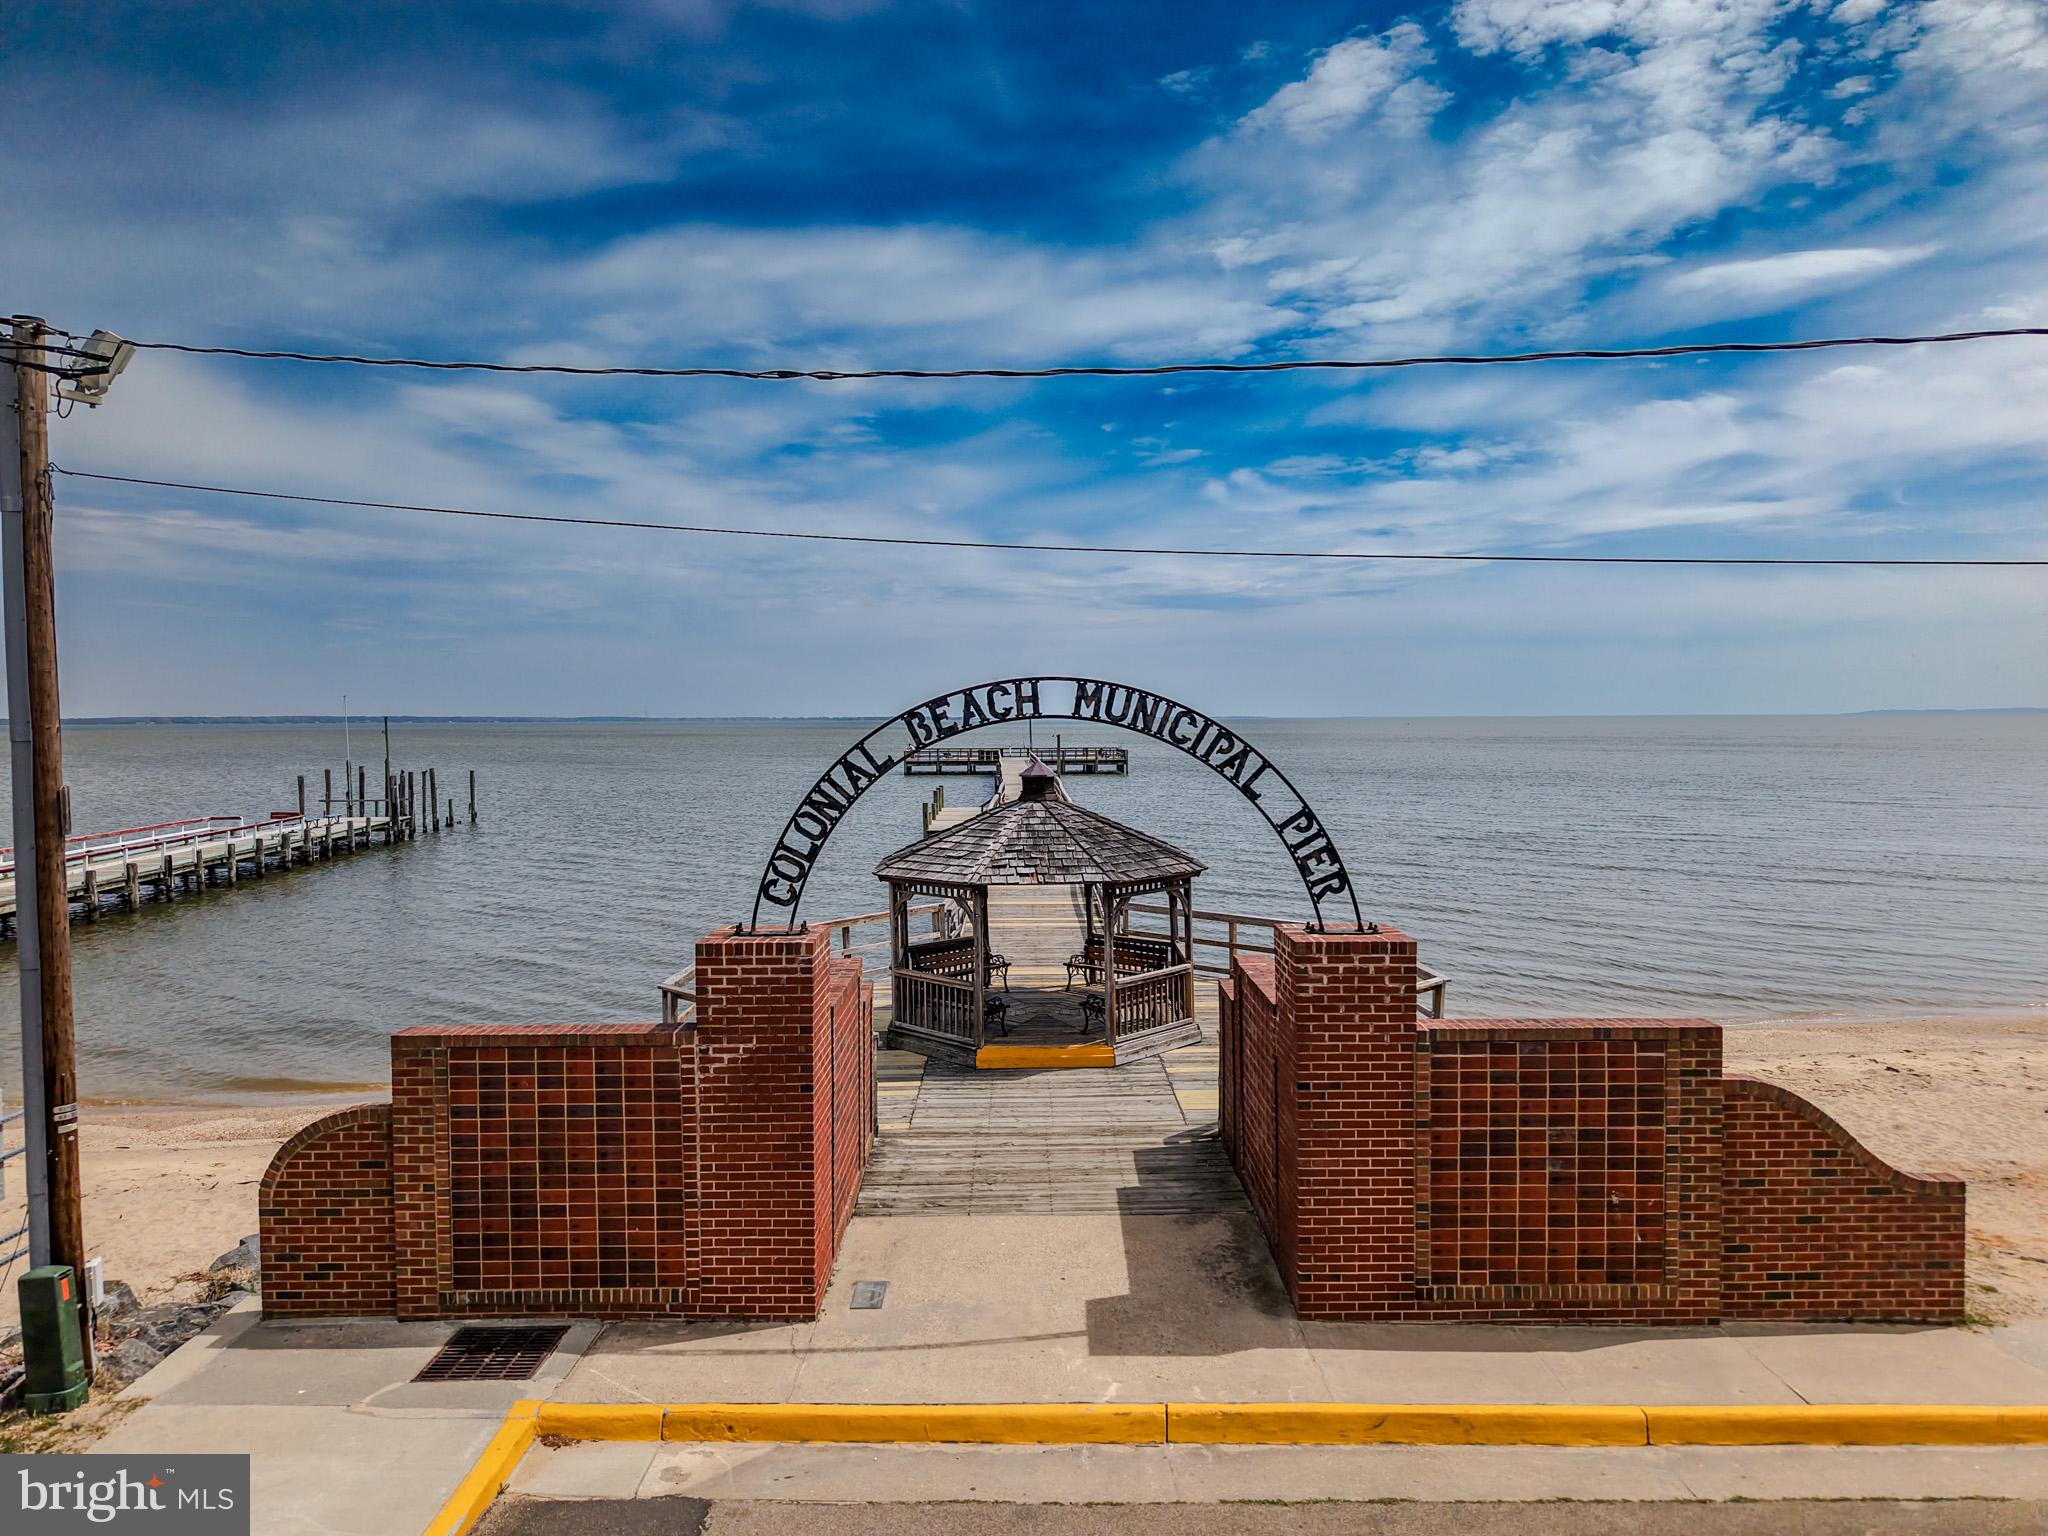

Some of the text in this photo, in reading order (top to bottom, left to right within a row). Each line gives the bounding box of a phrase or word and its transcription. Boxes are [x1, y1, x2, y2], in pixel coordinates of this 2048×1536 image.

[762, 680, 1347, 907] COLONIAL BEACH MUNICIPAL PIER
